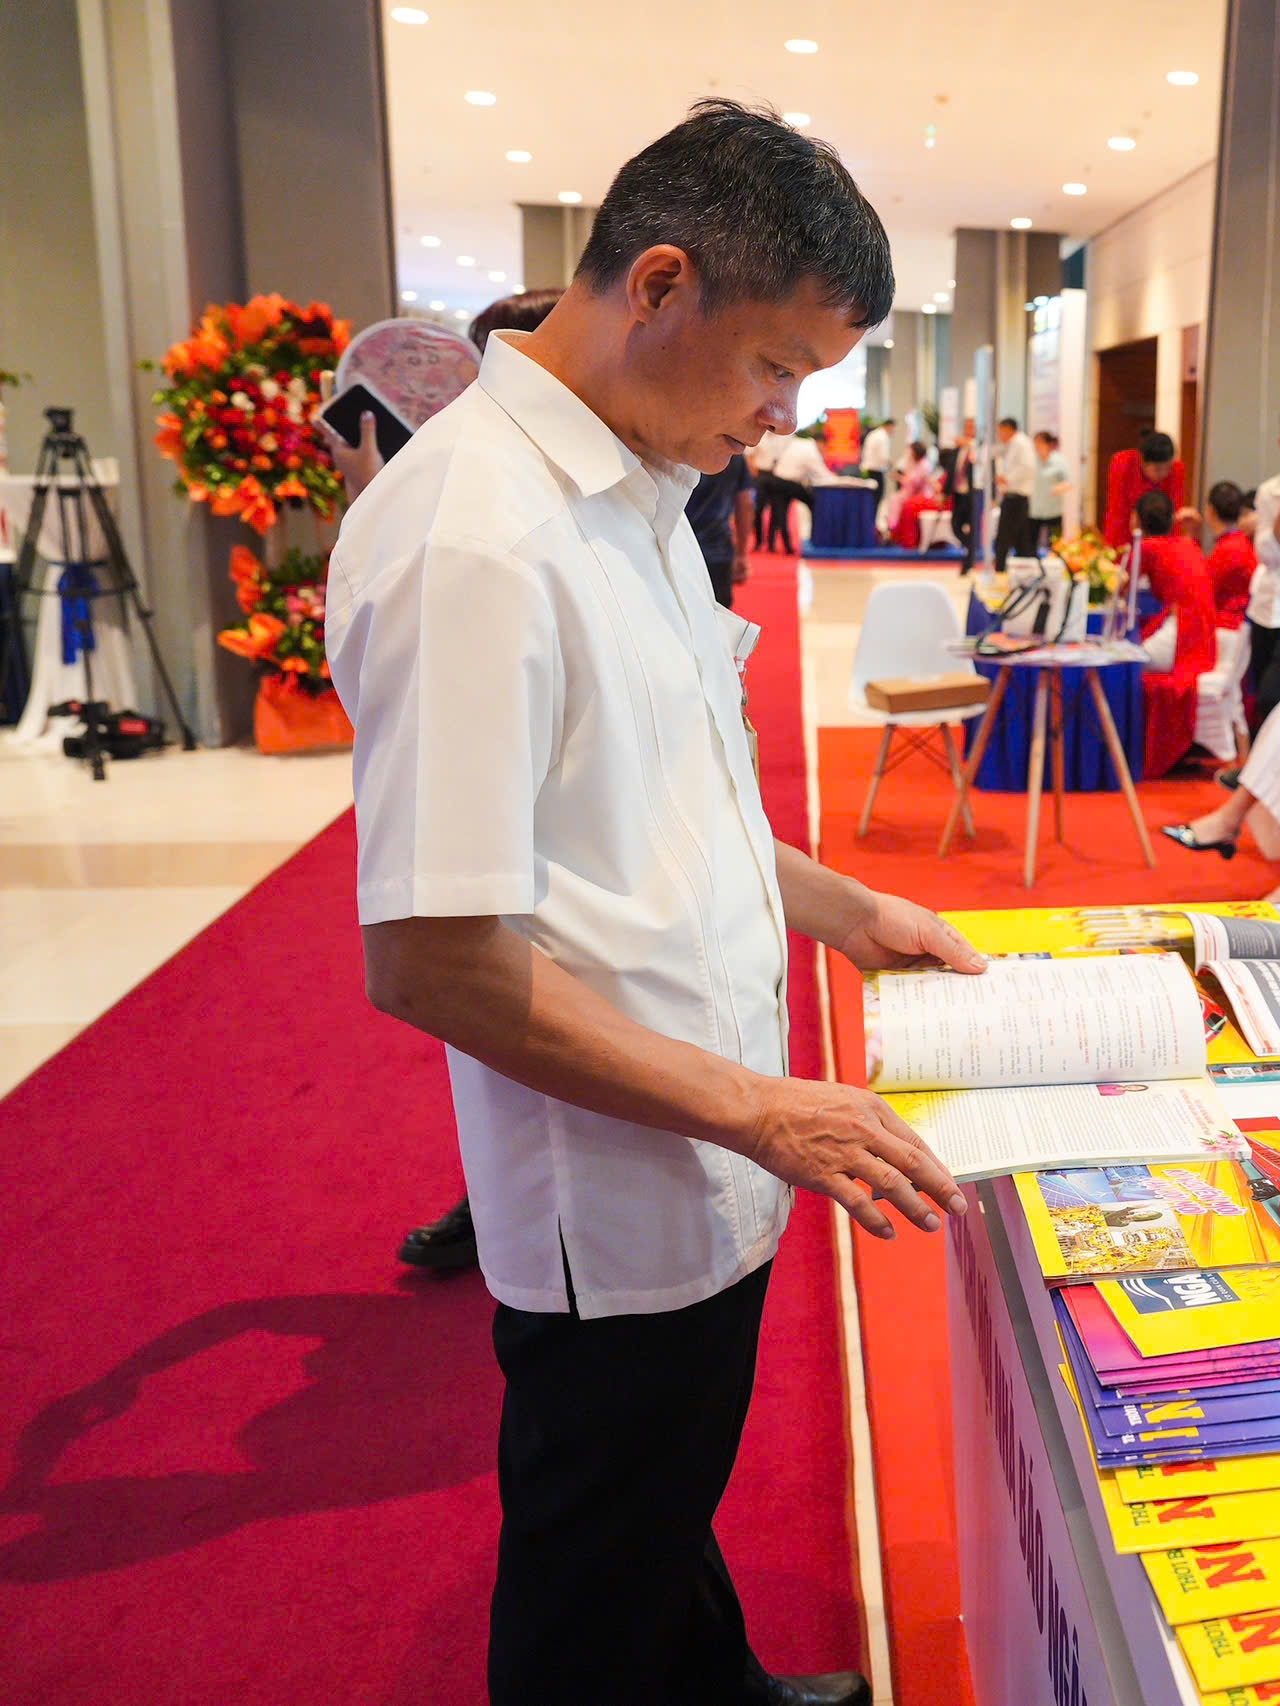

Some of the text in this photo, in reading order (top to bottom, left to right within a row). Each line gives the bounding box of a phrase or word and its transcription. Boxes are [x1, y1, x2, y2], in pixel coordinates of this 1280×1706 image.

[1163, 1273, 1223, 1306] NGÂ
[1019, 1436, 1043, 1635] BÁO
[1049, 1552, 1088, 1706] NGÂ
